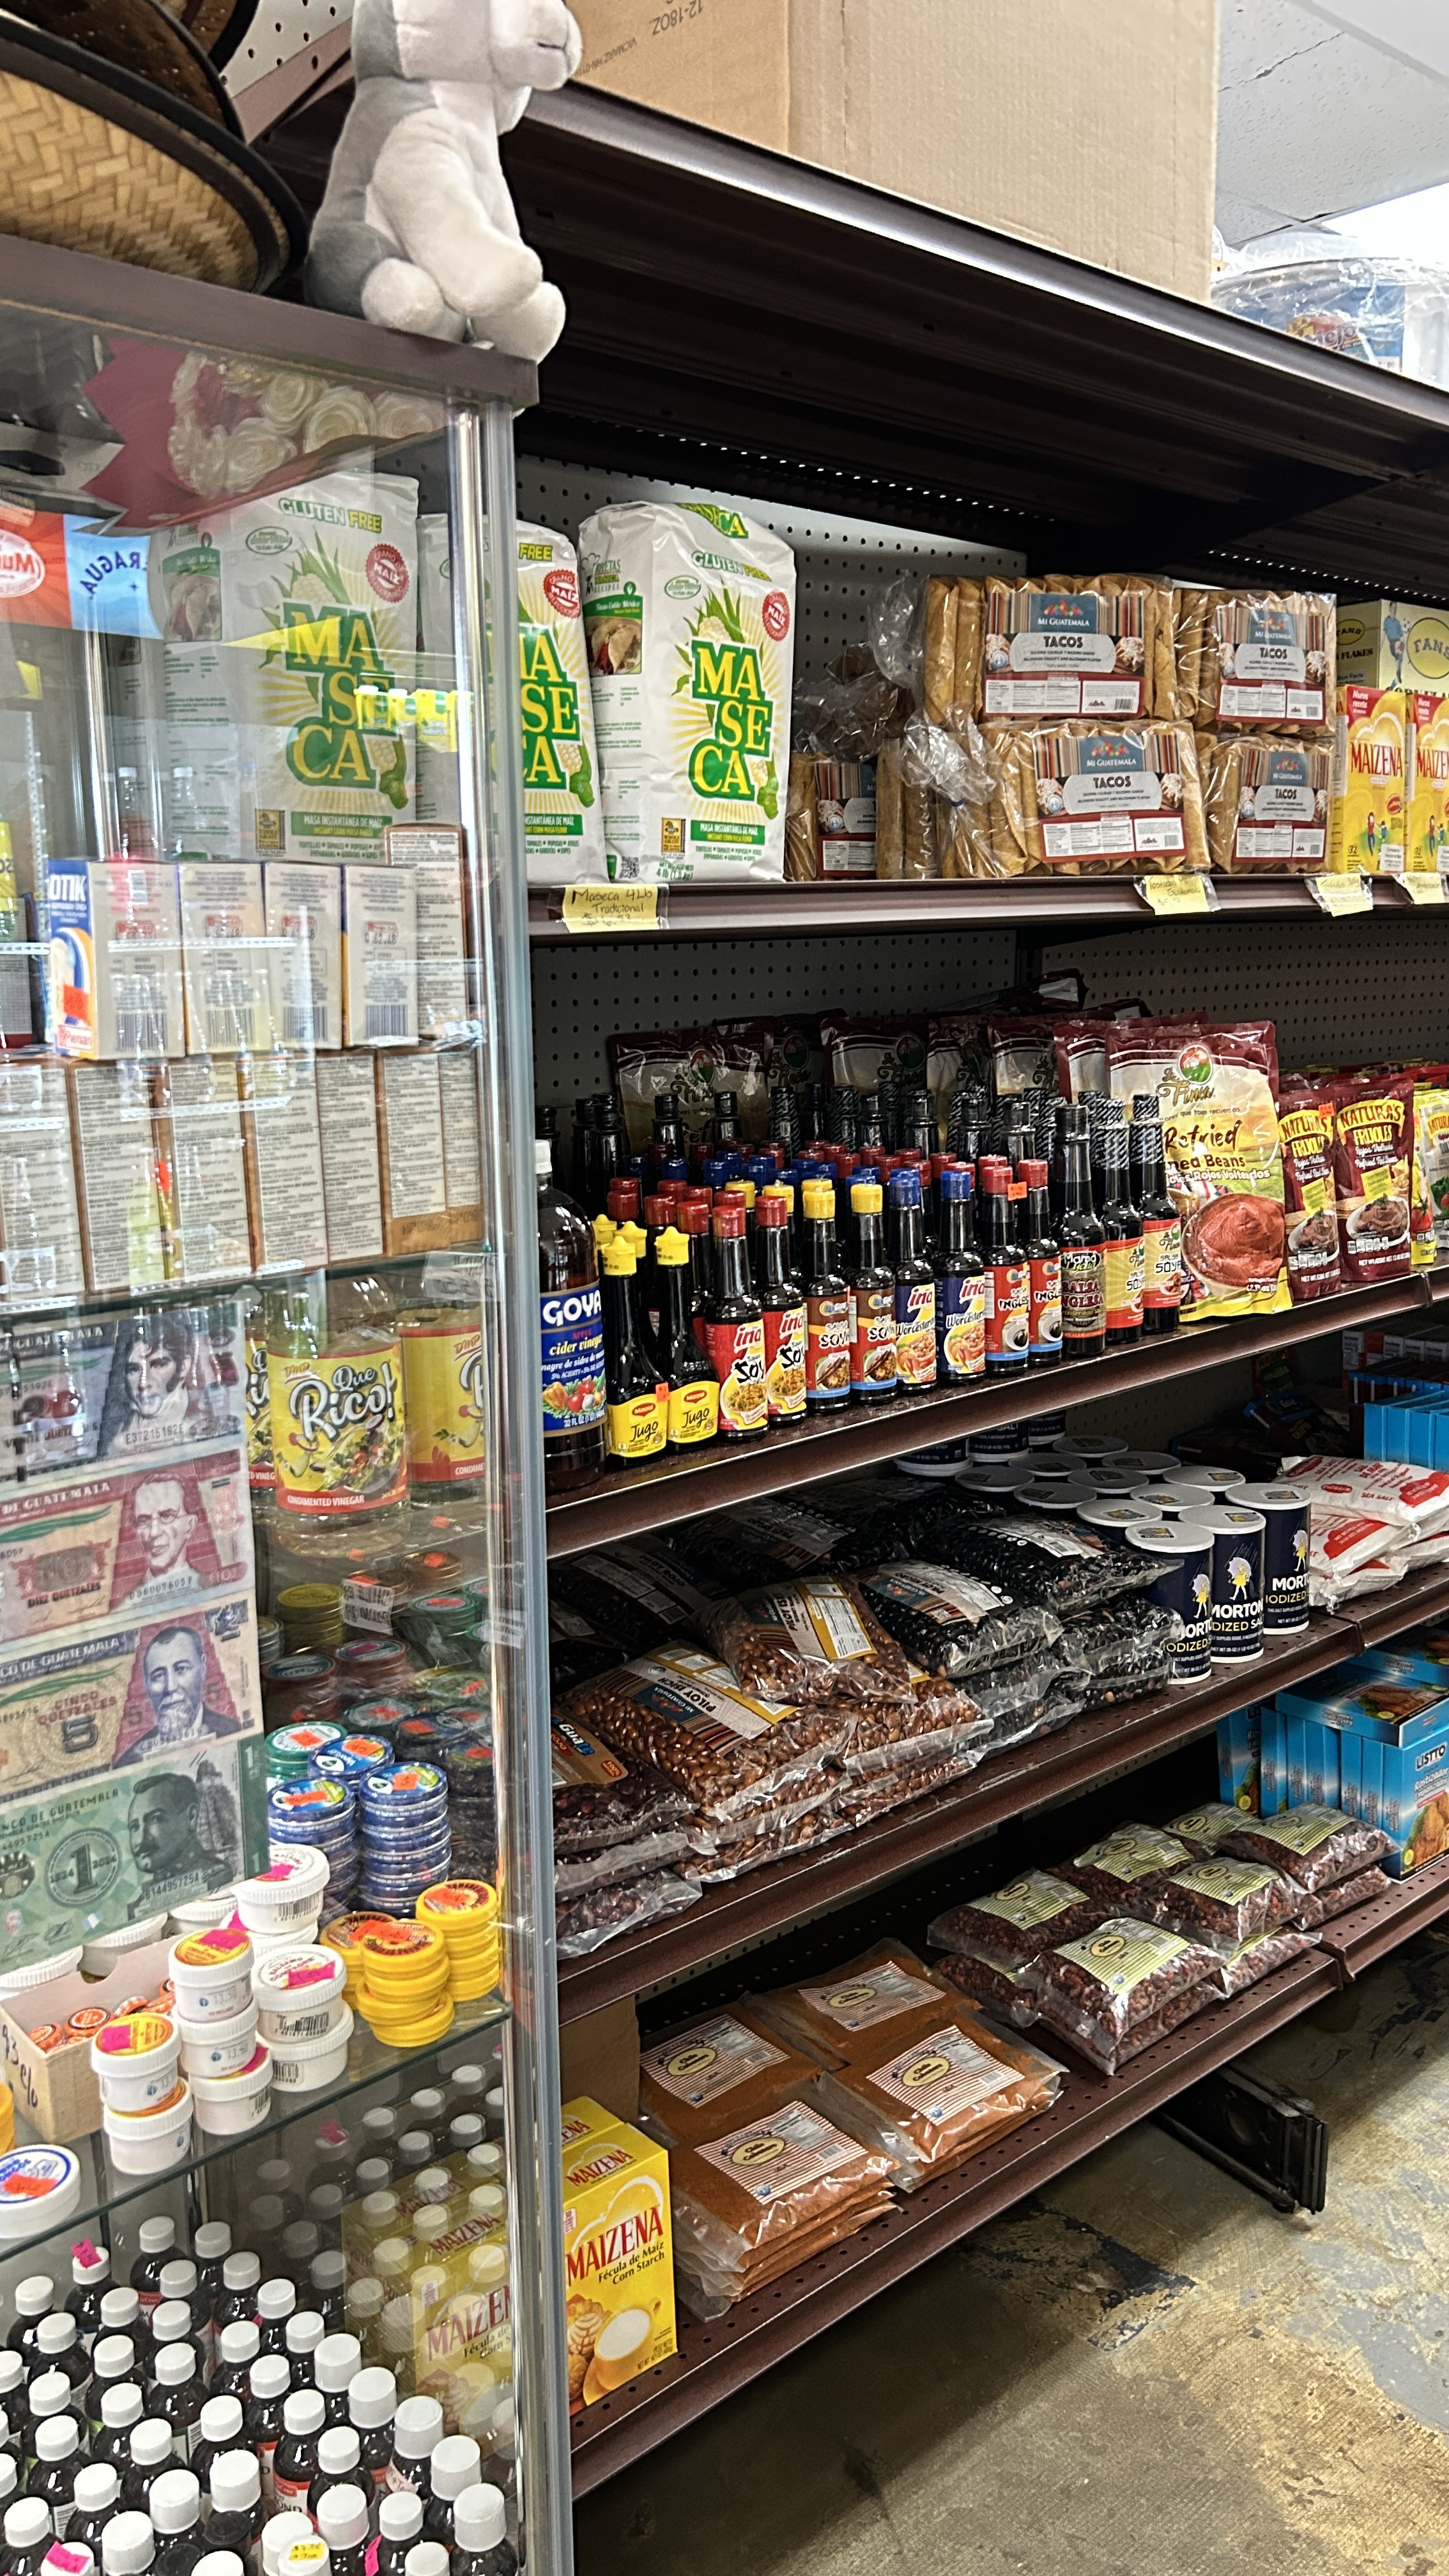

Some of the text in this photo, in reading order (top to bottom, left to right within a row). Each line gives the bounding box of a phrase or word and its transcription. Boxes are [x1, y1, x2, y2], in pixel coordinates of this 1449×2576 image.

[279, 497, 383, 533] GLUTEN FREE
[519, 542, 553, 562] FREE
[691, 549, 744, 575] GLUTEN
[1049, 617, 1090, 627] GUATEMALA
[290, 610, 378, 671] MA
[1043, 636, 1083, 648] TACOS
[1259, 647, 1288, 659] TACOS
[519, 632, 563, 683] A
[1342, 647, 1374, 660] FLAKES
[697, 647, 762, 701] MA
[328, 671, 390, 727] SE
[719, 700, 769, 751] SE
[292, 724, 371, 782] CA
[1097, 758, 1137, 767] GUATEMALA
[1350, 741, 1403, 778] MAIZENA
[693, 745, 751, 796] CA
[1093, 775, 1131, 789] TACOS
[1275, 788, 1298, 800] TACOS
[656, 868, 663, 877] 4
[663, 868, 669, 878] lb
[571, 888, 620, 906] Maseca
[591, 901, 644, 915] Tradicional
[1156, 1078, 1215, 1107] Finca
[1340, 1103, 1402, 1128] NATURA'S
[1163, 1119, 1243, 1151] Refried
[1353, 1124, 1393, 1146] FRIJOLES
[1205, 1153, 1246, 1170] Beans
[1193, 1169, 1222, 1182] Rojos
[1155, 1261, 1181, 1274] SOYA
[1062, 1278, 1100, 1294] SALSA
[542, 1289, 601, 1326] GOYA
[1062, 1292, 1105, 1308] NGLESA
[549, 1340, 577, 1356] cider
[565, 1359, 573, 1368] de
[332, 1367, 376, 1392] Que
[289, 1361, 397, 1441] Rico!
[682, 1407, 710, 1429] Jugo
[629, 1420, 659, 1443] Jugo
[2, 1482, 111, 1514] DE GUATEMALA
[287, 1494, 365, 1506] CONDIMENTED VINEGAR
[1375, 1493, 1396, 1501] SALT
[27, 1581, 101, 1609] DIEZ QUETZALES
[1265, 1592, 1307, 1604] IODIZED
[40, 1637, 120, 1667] GUATEMALA
[54, 1690, 99, 1710] CINCO
[204, 1681, 221, 1703] 5
[683, 1690, 716, 1712] PILOY
[38, 1696, 117, 1726] QUETZALES
[128, 1705, 142, 1724] 5
[63, 1714, 100, 1754] 5
[1416, 1744, 1446, 1770] LISTTO
[31, 1788, 119, 1823] DE GUATEMALA
[71, 1842, 98, 1895] 1
[91, 1855, 117, 1871] 2024
[565, 2149, 634, 2188] MAIZENA
[429, 2213, 500, 2255] MAIZENA
[565, 2205, 664, 2288] MAIZENA
[598, 2241, 664, 2285] Fécula de Maíz
[612, 2250, 665, 2285] Corn Starch
[463, 2326, 509, 2358] Fécula de
